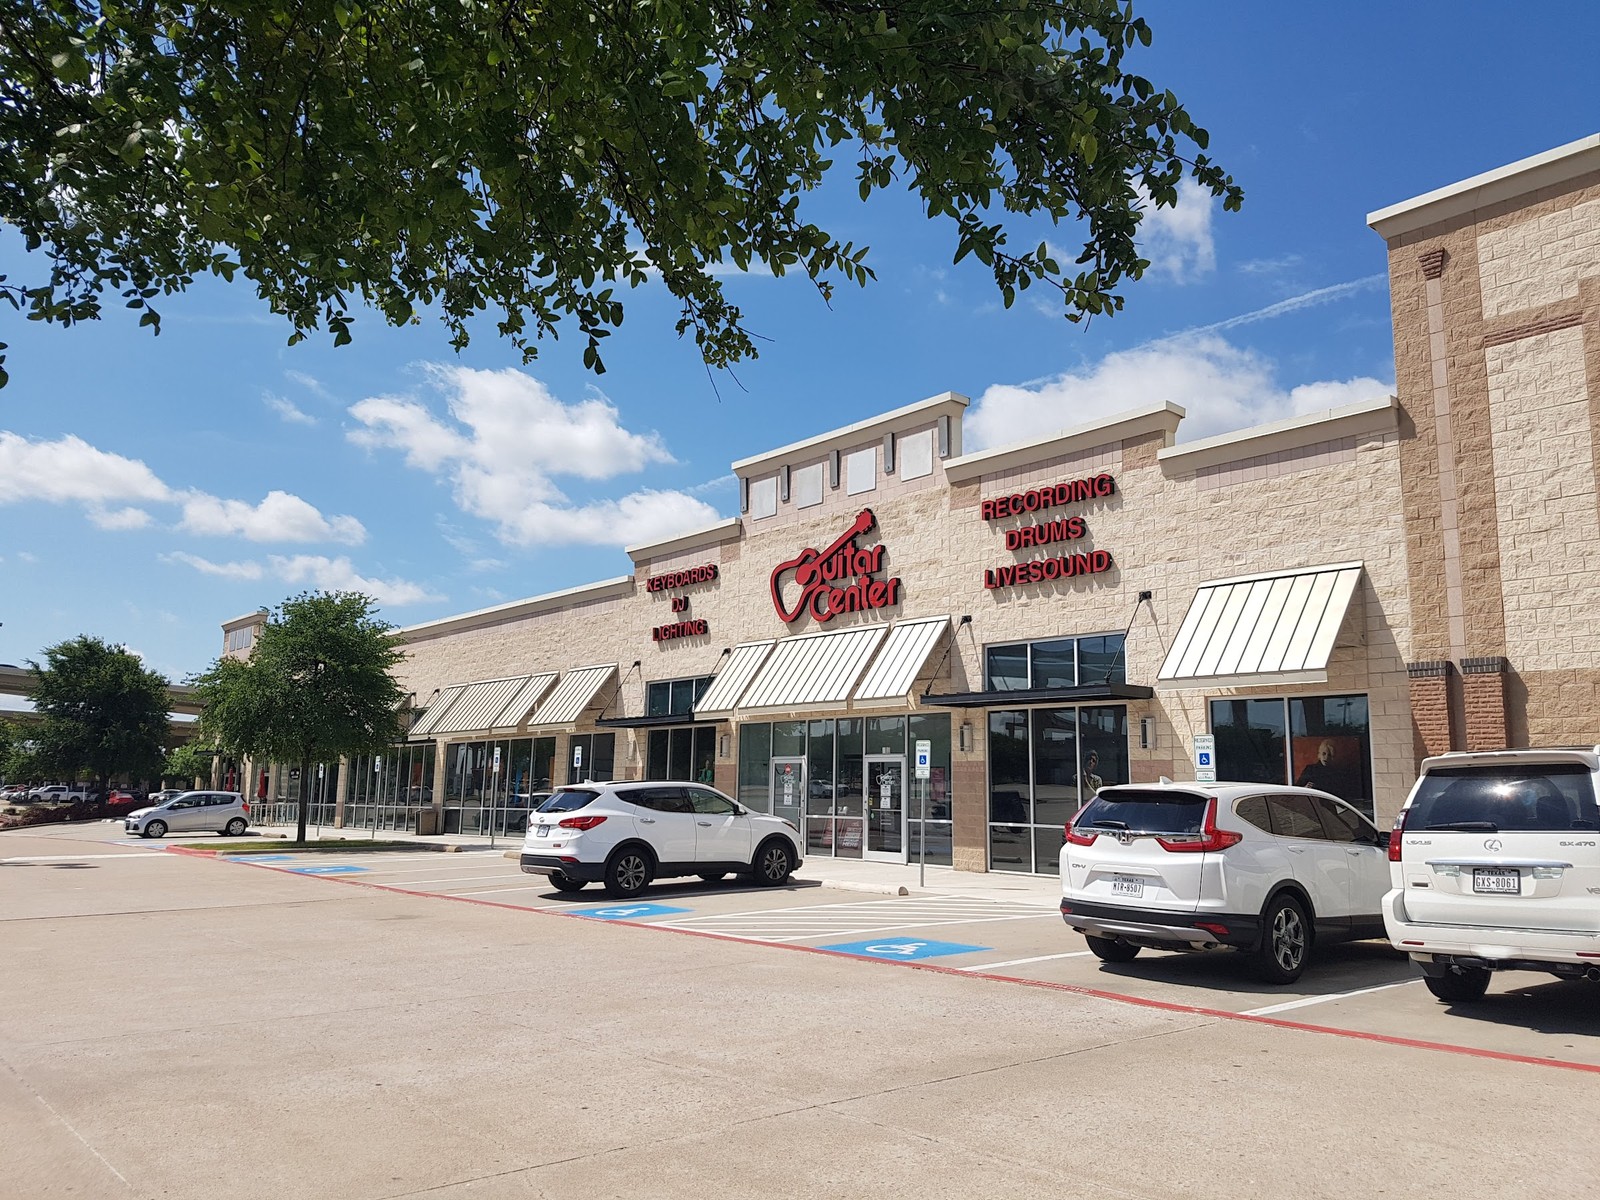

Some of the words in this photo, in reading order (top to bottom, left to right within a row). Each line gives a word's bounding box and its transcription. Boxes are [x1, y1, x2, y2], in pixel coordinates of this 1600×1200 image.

[982, 474, 1115, 520] RECORDING
[1005, 517, 1086, 550] DRUMS
[647, 564, 718, 592] KEYBOARDS
[984, 550, 1111, 589] LIVESOUND
[672, 596, 689, 612] DJ
[810, 574, 901, 621] Center
[653, 619, 708, 641] LIGHTING
